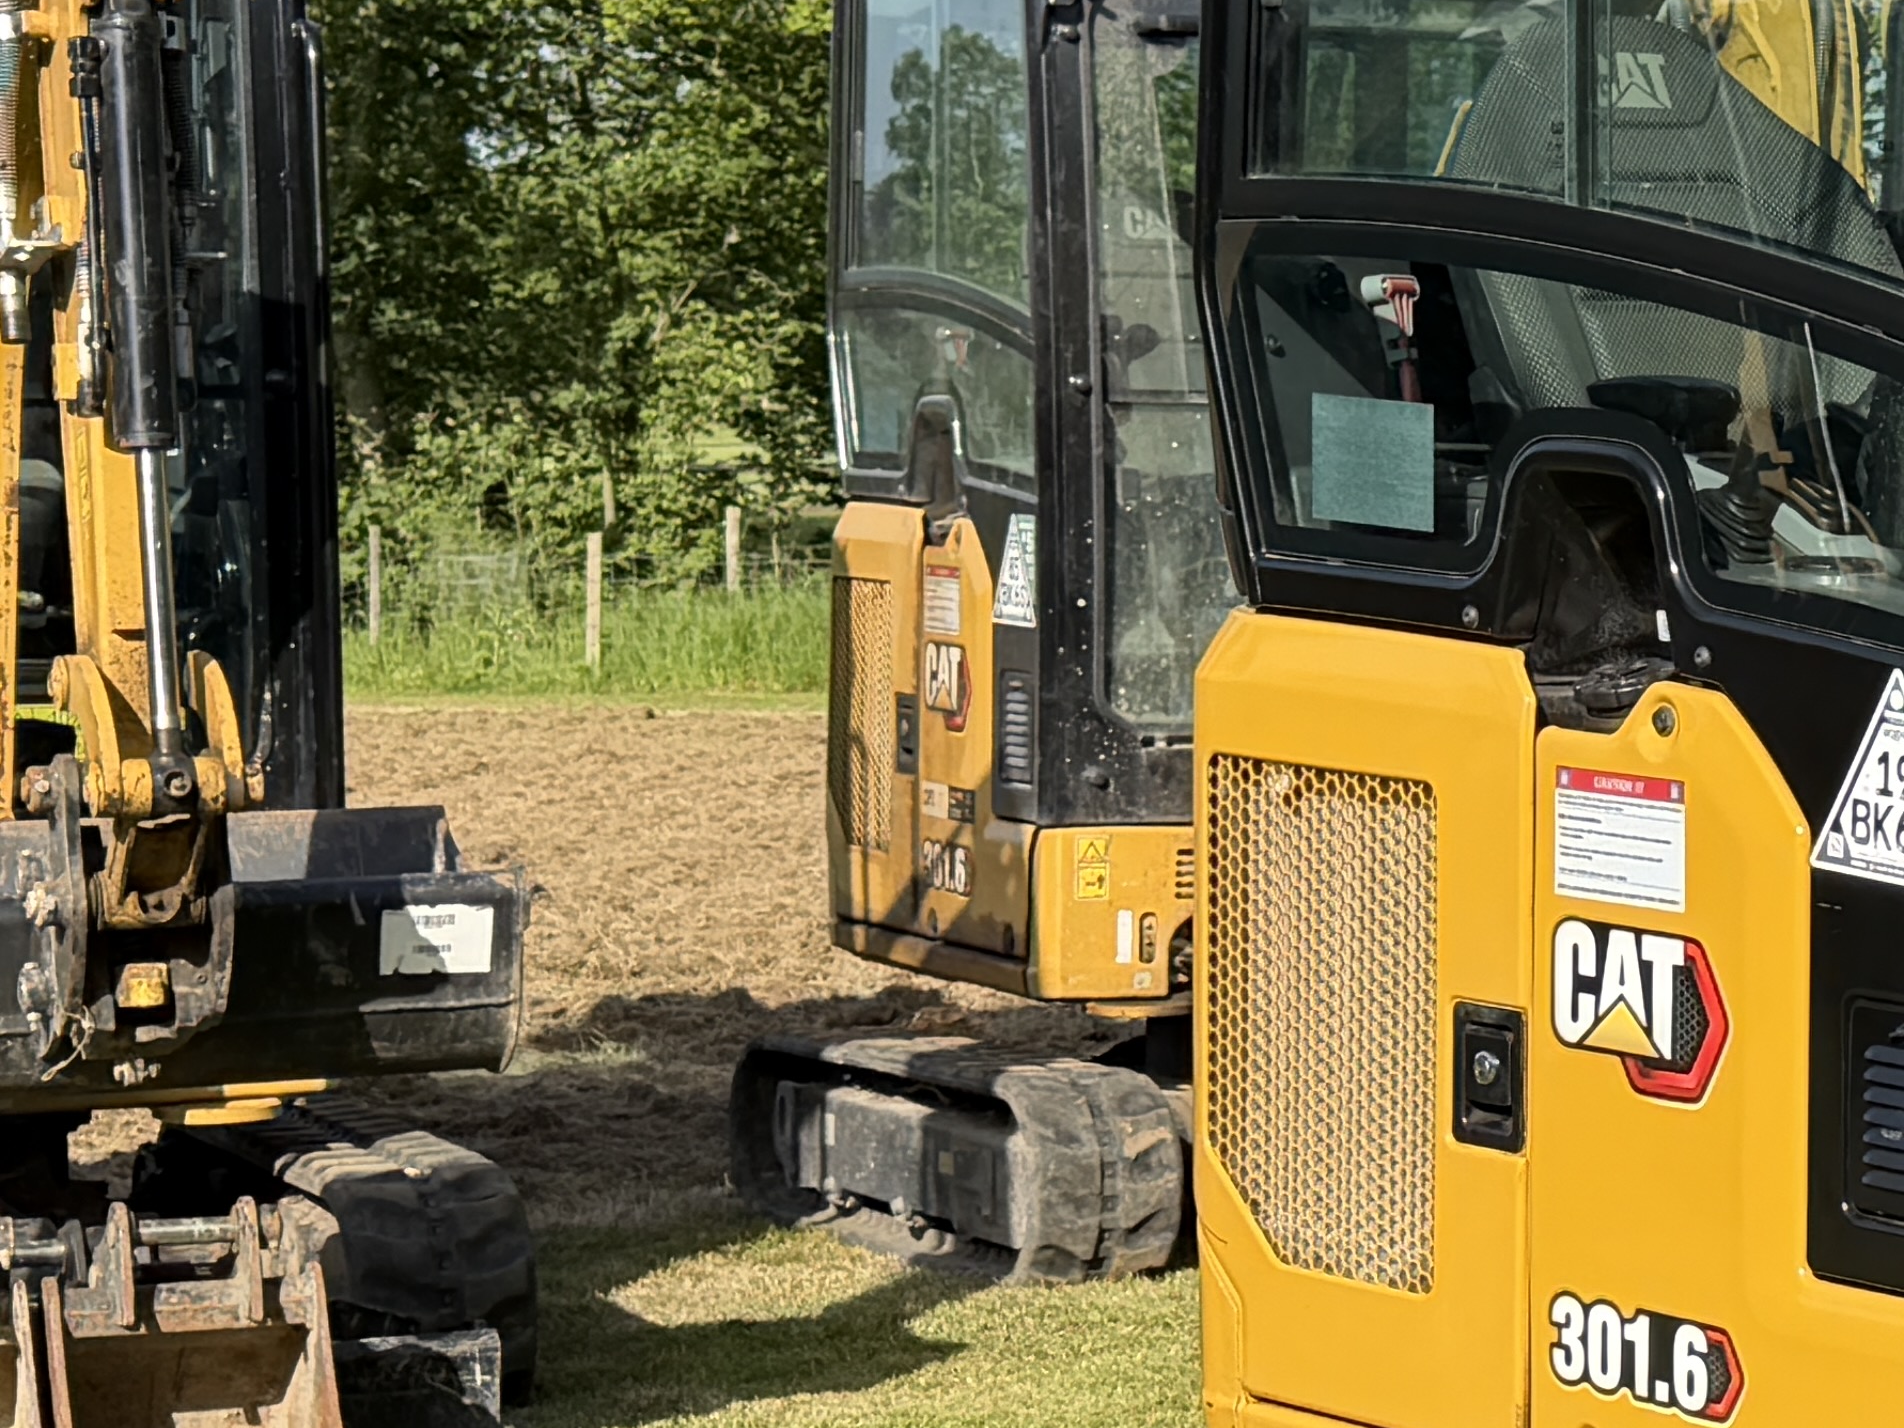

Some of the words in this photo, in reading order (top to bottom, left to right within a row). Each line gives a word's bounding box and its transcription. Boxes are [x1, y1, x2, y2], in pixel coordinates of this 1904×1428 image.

[925, 642, 961, 712] CAT
[1554, 919, 1685, 1060] CAT
[1551, 1295, 1709, 1412] 301.6
